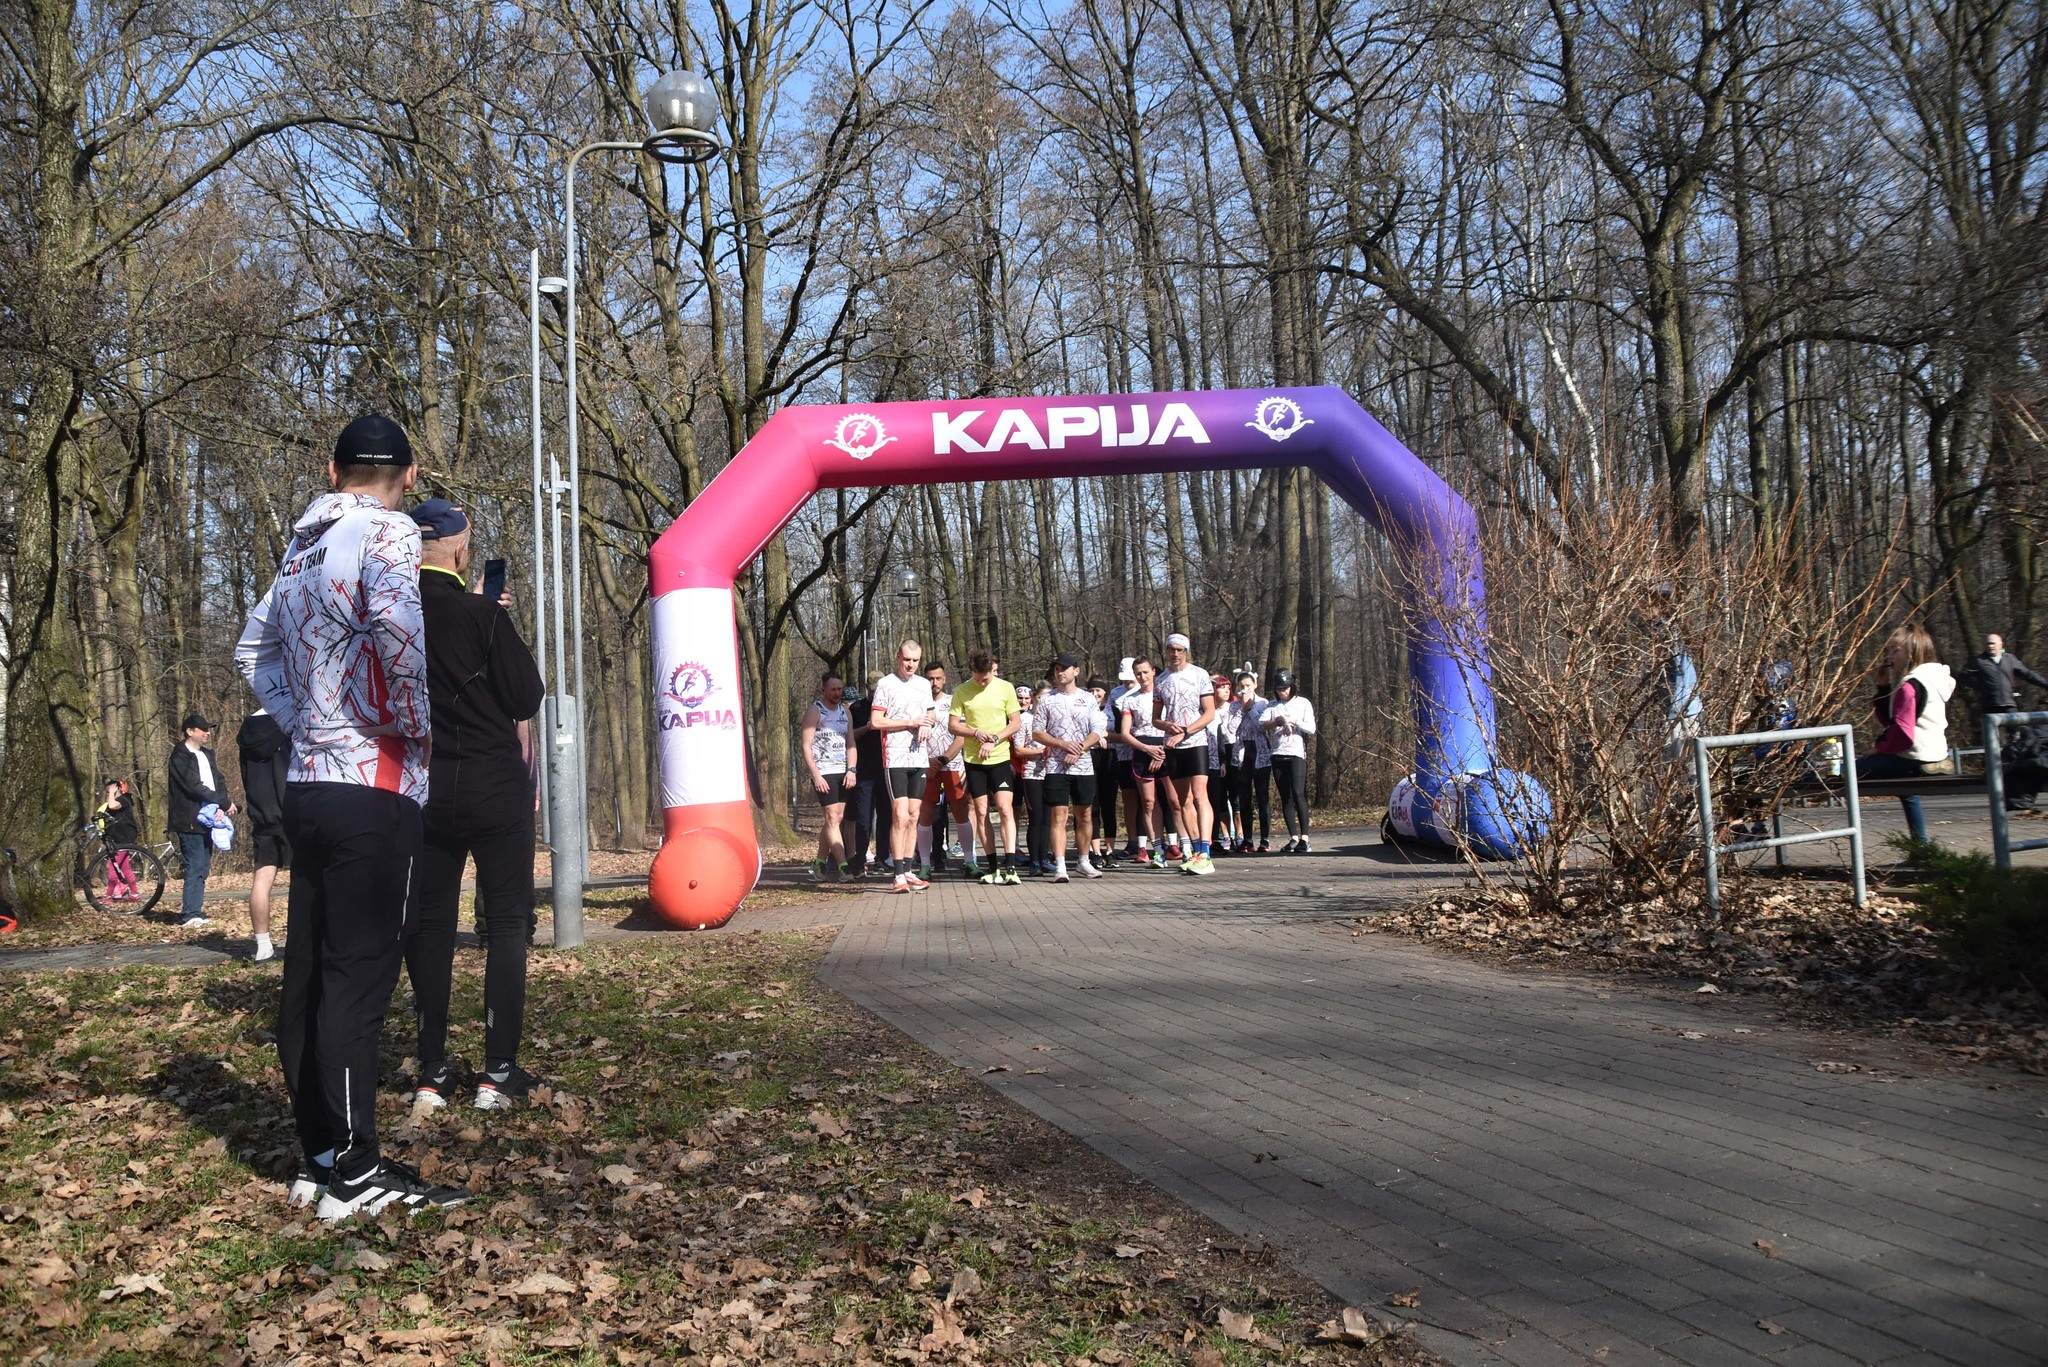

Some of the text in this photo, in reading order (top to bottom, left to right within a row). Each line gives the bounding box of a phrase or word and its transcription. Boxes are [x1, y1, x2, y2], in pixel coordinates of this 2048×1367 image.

[931, 402, 1212, 455] KAPIJA
[304, 546, 328, 571] TEAM
[659, 709, 737, 731] KAPIJA
